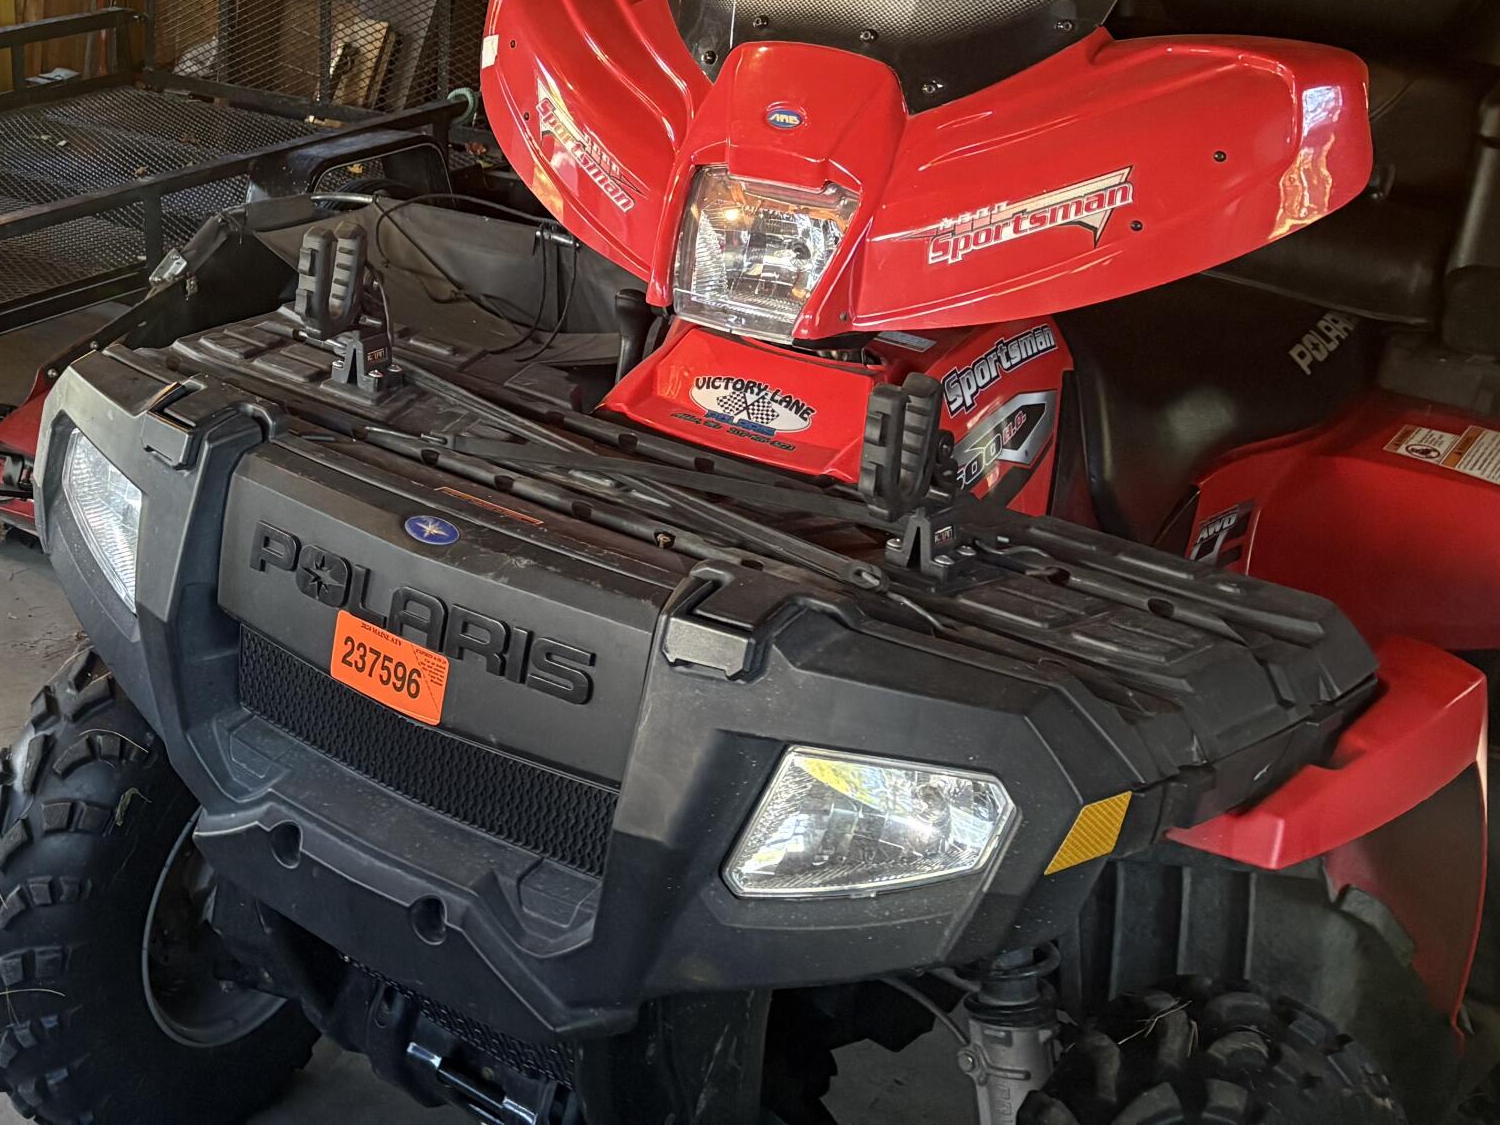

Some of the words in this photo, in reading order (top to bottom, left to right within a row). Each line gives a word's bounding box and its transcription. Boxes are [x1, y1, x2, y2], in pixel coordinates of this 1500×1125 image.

[536, 97, 635, 213] Sportsman
[928, 183, 1134, 264] Sportsman
[695, 376, 769, 396] VICTORY
[770, 388, 815, 421] LANE
[941, 324, 1058, 417] Sportsman
[1196, 513, 1237, 544] AWD
[250, 520, 596, 705] POLARIS
[341, 636, 422, 699] 237596
